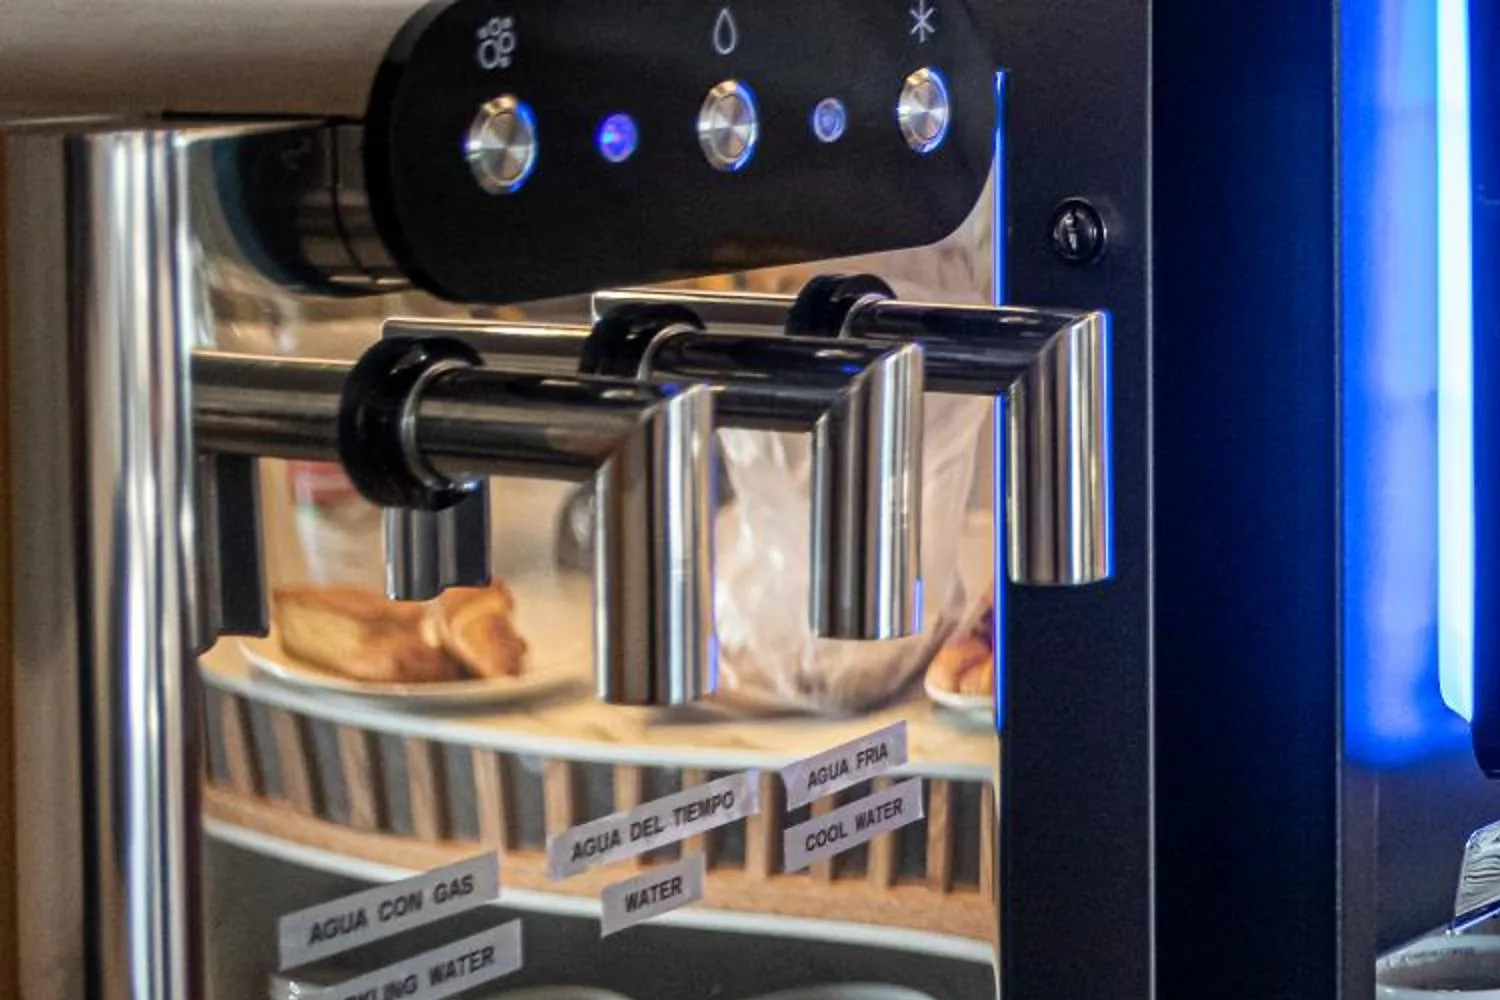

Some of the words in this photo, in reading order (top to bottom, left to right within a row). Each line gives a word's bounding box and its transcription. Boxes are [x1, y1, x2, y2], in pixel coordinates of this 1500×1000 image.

[806, 759, 849, 789] AGUA
[855, 742, 889, 770] FRIA
[570, 829, 622, 862] AGUA
[629, 817, 664, 842] DEL
[671, 790, 736, 827] TIEMPO
[804, 823, 849, 852] COOL
[855, 797, 905, 830] WATER
[308, 908, 368, 944] AGUA
[377, 889, 424, 923] CON
[433, 874, 474, 902] GAS
[624, 875, 683, 913] WATER
[427, 945, 495, 986] WATER
